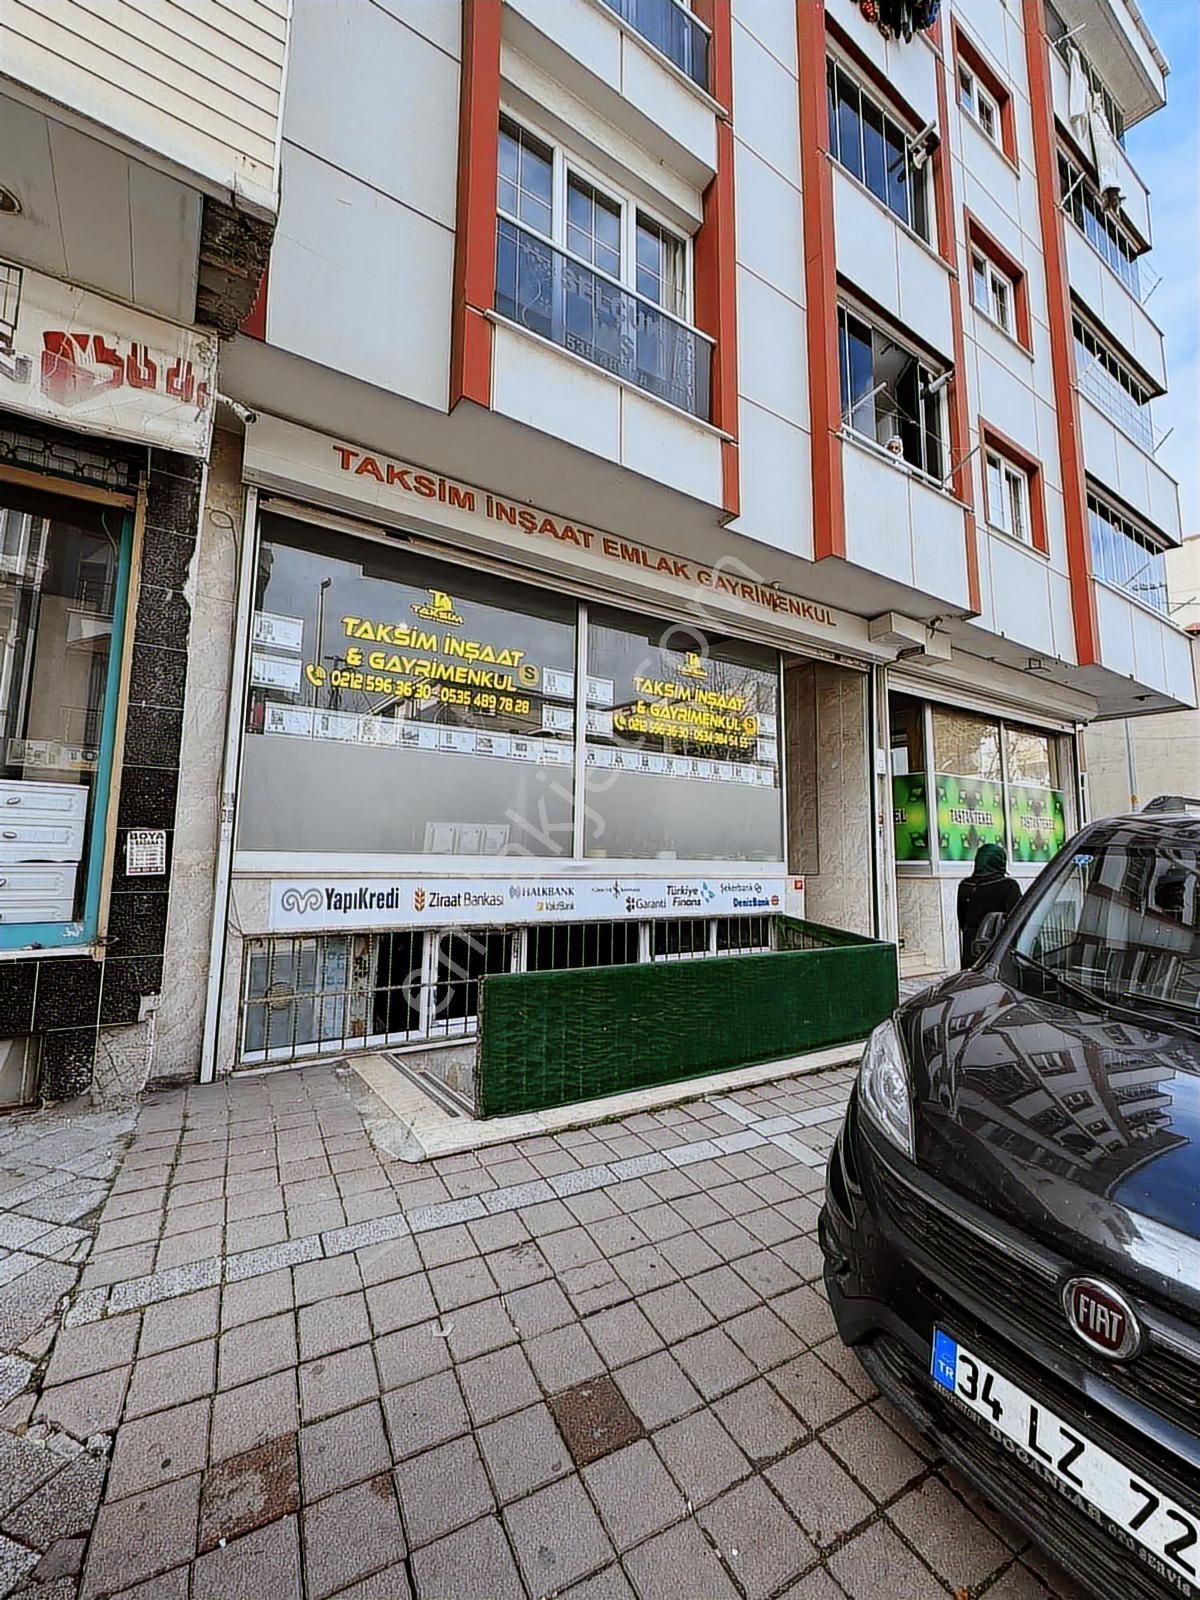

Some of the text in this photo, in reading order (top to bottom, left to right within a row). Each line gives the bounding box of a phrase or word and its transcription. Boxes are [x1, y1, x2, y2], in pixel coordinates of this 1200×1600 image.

[333, 445, 837, 627] TAKSİM İNŞAAT EMLAK GAYRİMENKUL
[341, 616, 437, 652] TAKSİM
[443, 633, 525, 668] İNŞAAT
[346, 647, 363, 666] &
[368, 651, 518, 693] GAYRİMENKUL
[331, 669, 530, 714] 0212 596 36 30 0535 489 78 28
[633, 676, 691, 701] TAKSİM
[694, 684, 745, 712] İNŞAAT
[650, 702, 742, 732] GAYRİMENKUL
[129, 831, 164, 840] BOYA
[429, 892, 461, 908] Ziraat
[522, 885, 575, 897] HALKBANK
[636, 898, 667, 911] Garanti
[666, 884, 699, 897] Türkiye
[672, 896, 701, 907] Finans
[1079, 1293, 1124, 1343] FIAT
[937, 1359, 955, 1382] TR
[957, 1354, 1004, 1422] 34
[1027, 1404, 1086, 1489] LZ
